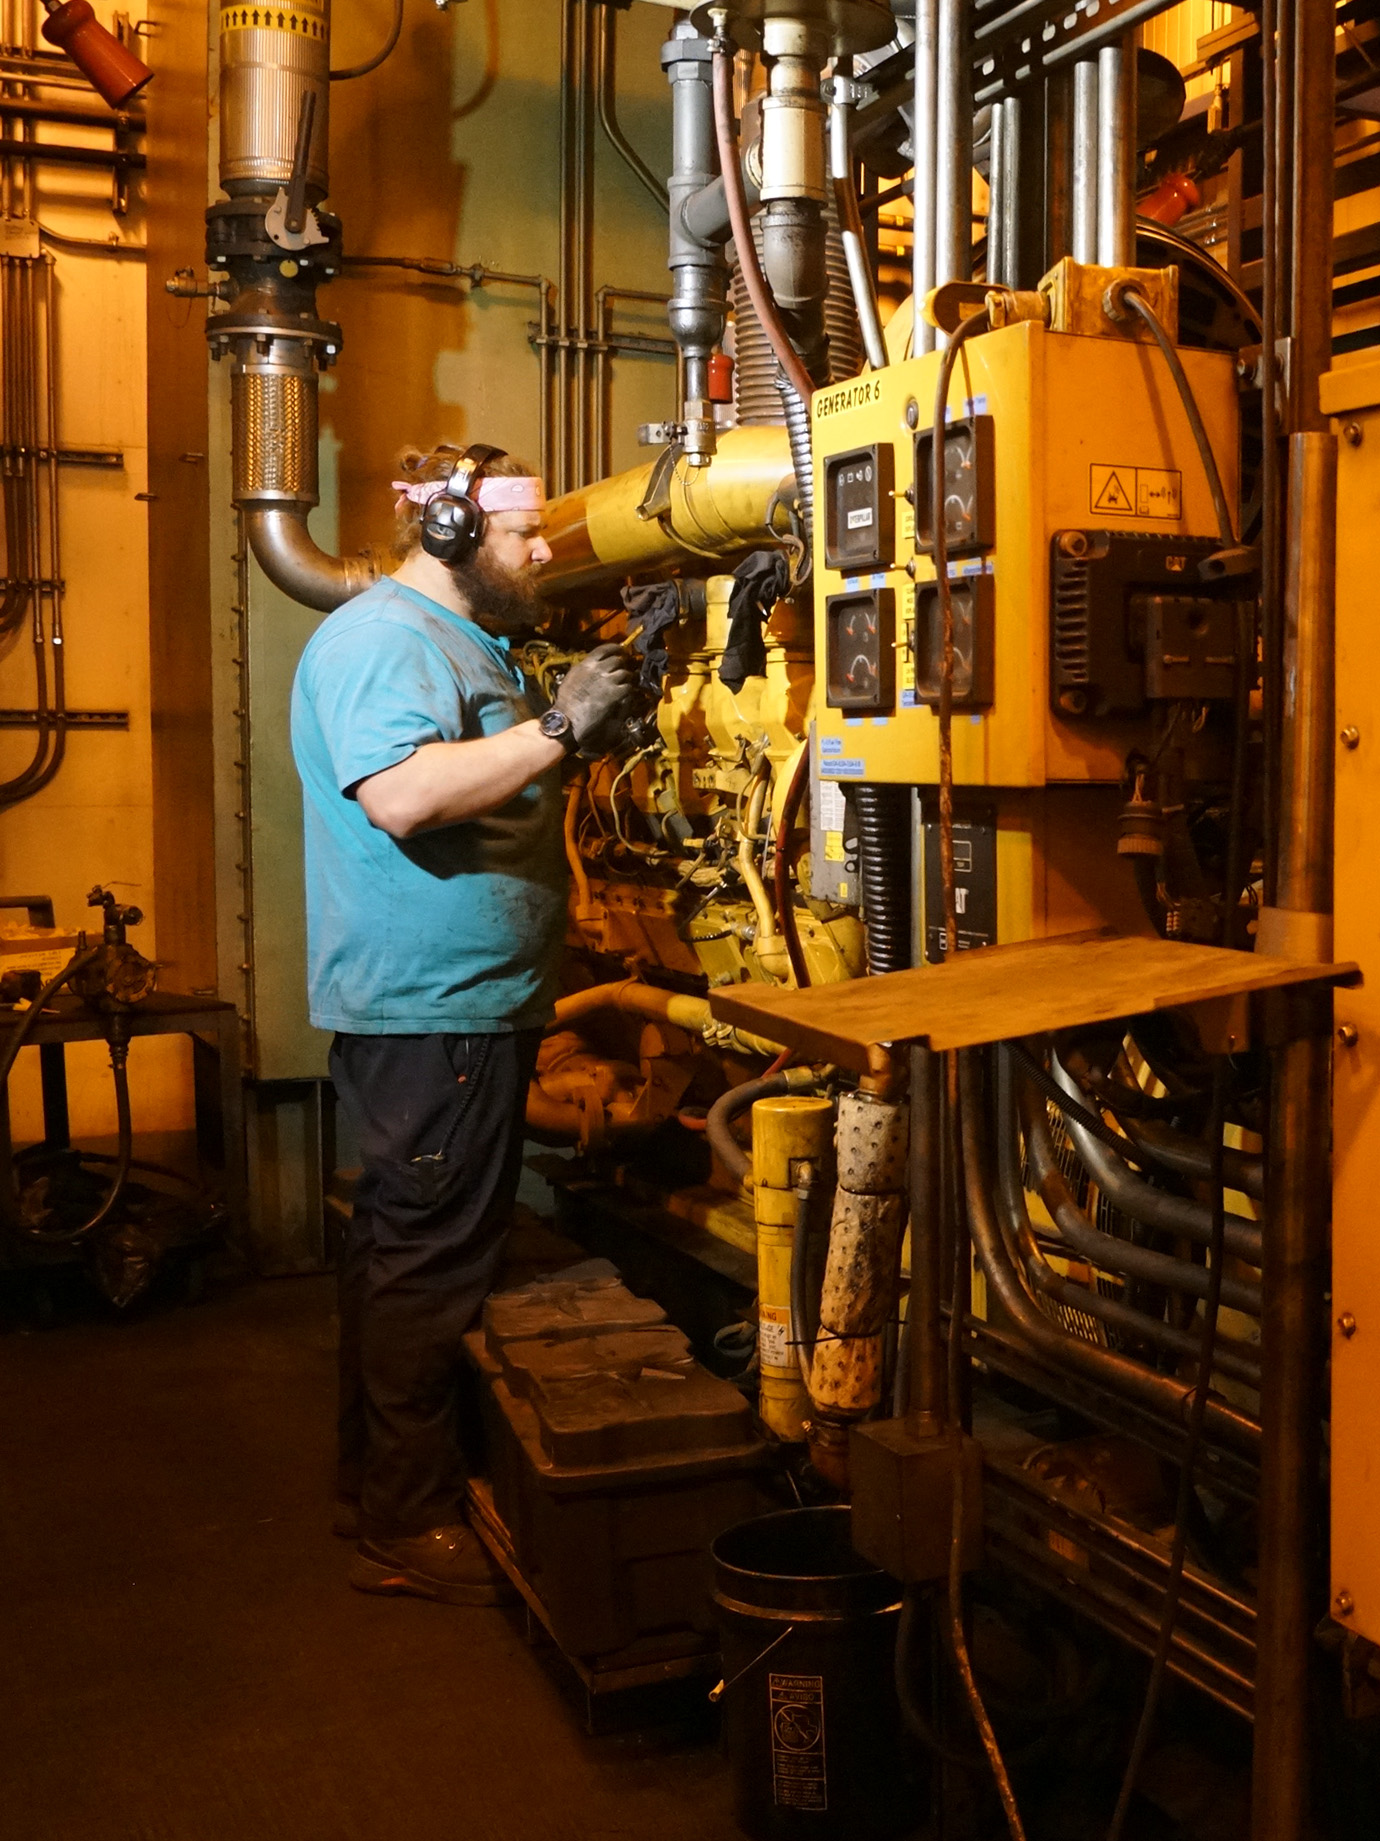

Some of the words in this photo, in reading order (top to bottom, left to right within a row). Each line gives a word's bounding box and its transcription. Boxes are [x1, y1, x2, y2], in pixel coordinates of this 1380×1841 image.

[817, 386, 871, 418] GENERATOR
[874, 379, 881, 400] 6
[780, 1678, 822, 1689] WARNING
